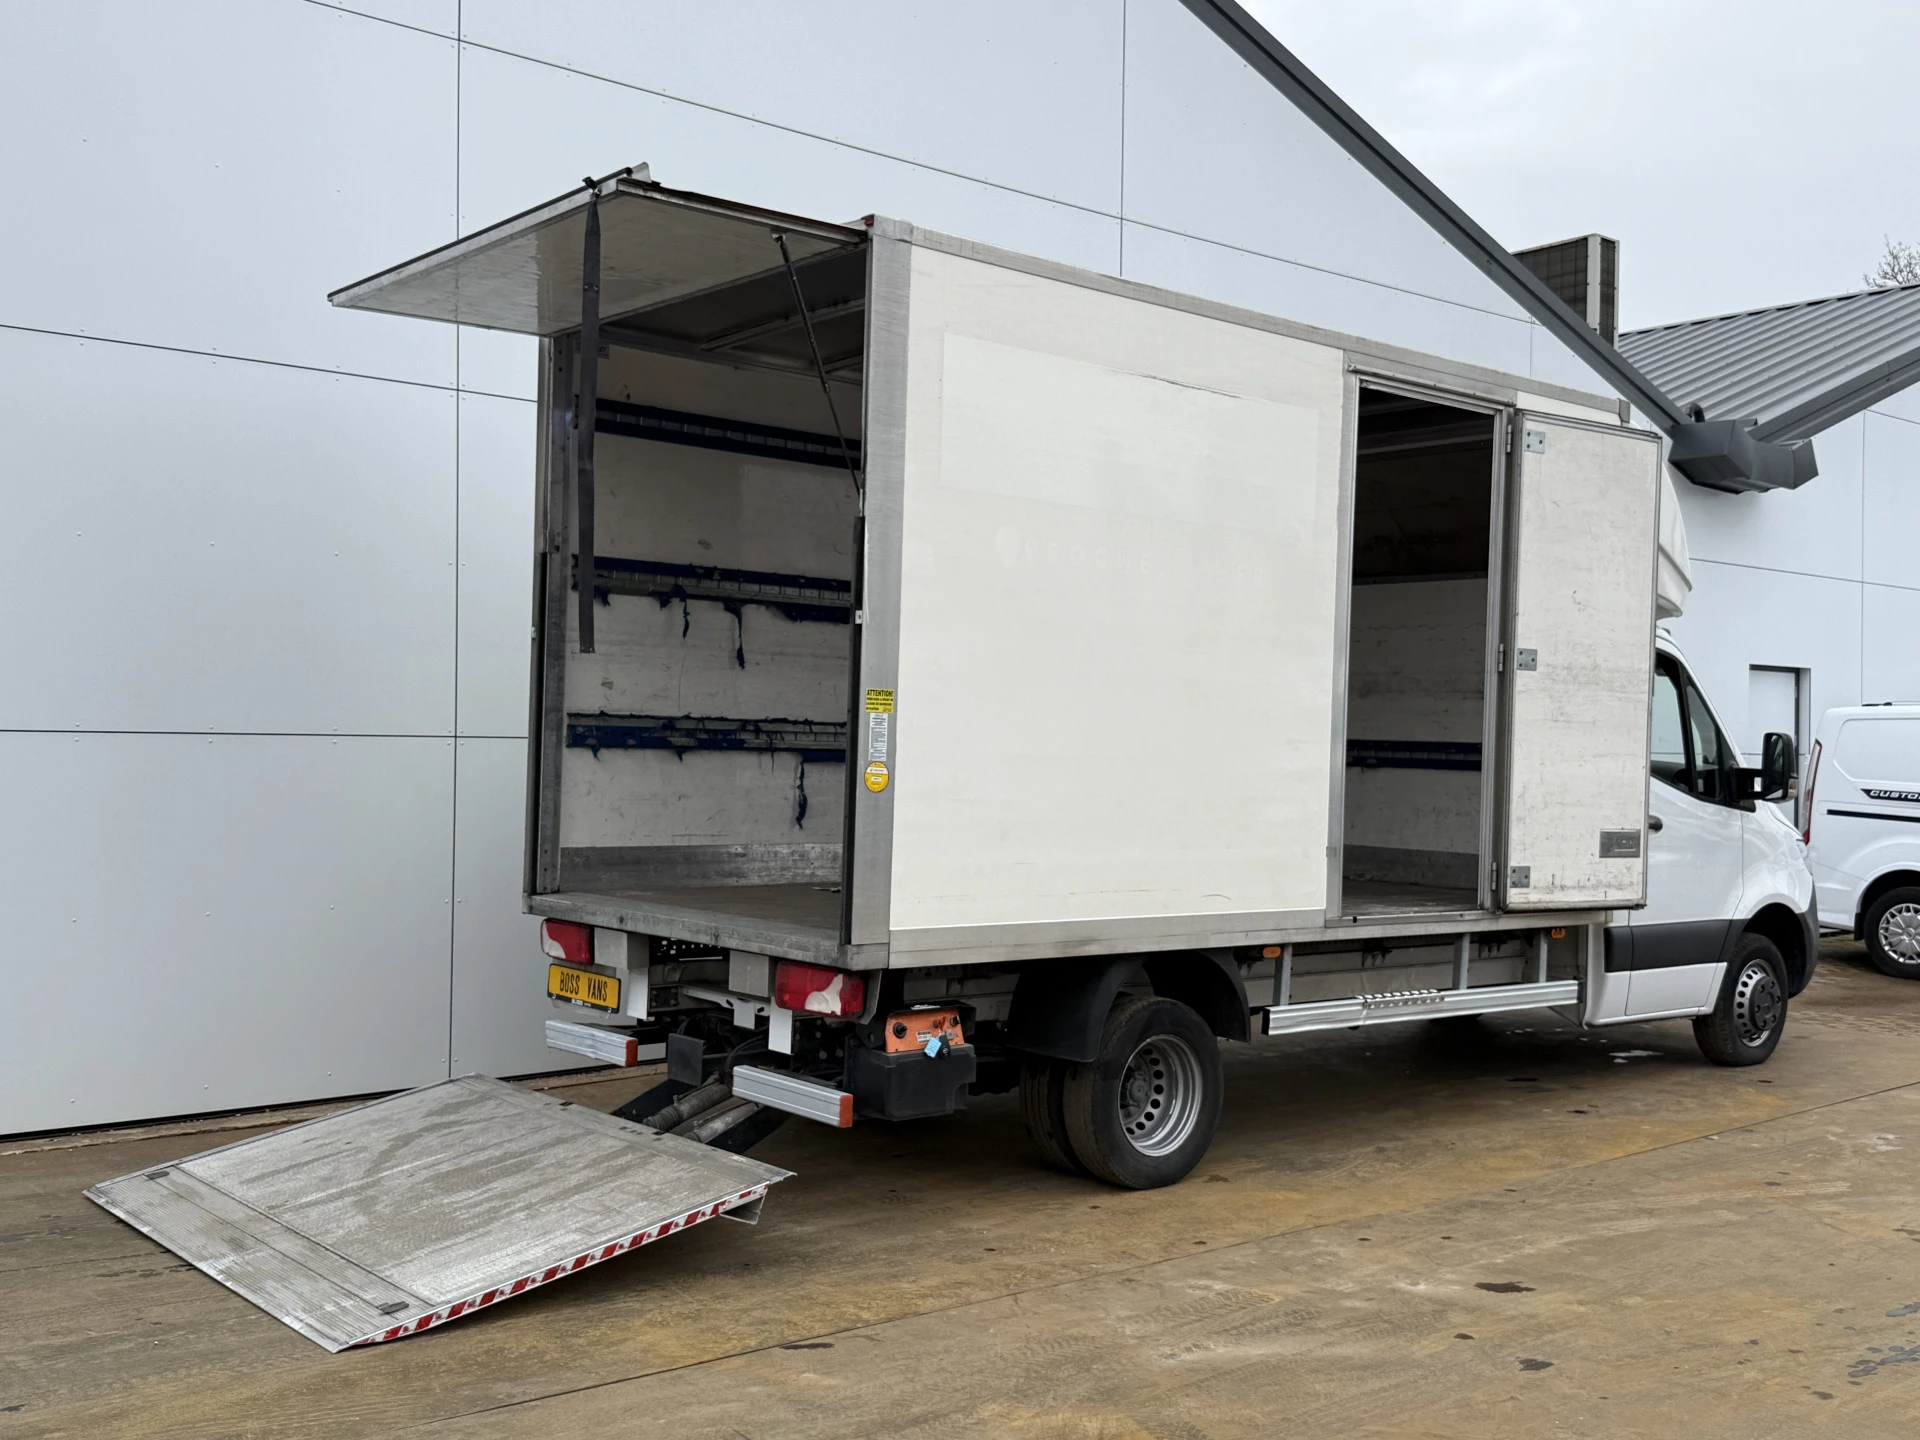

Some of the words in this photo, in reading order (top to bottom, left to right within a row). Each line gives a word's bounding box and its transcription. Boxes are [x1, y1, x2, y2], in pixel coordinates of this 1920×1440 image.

[1870, 790, 1920, 799] CUSTO
[560, 972, 580, 995] BOSS
[587, 977, 607, 1001] VANS
